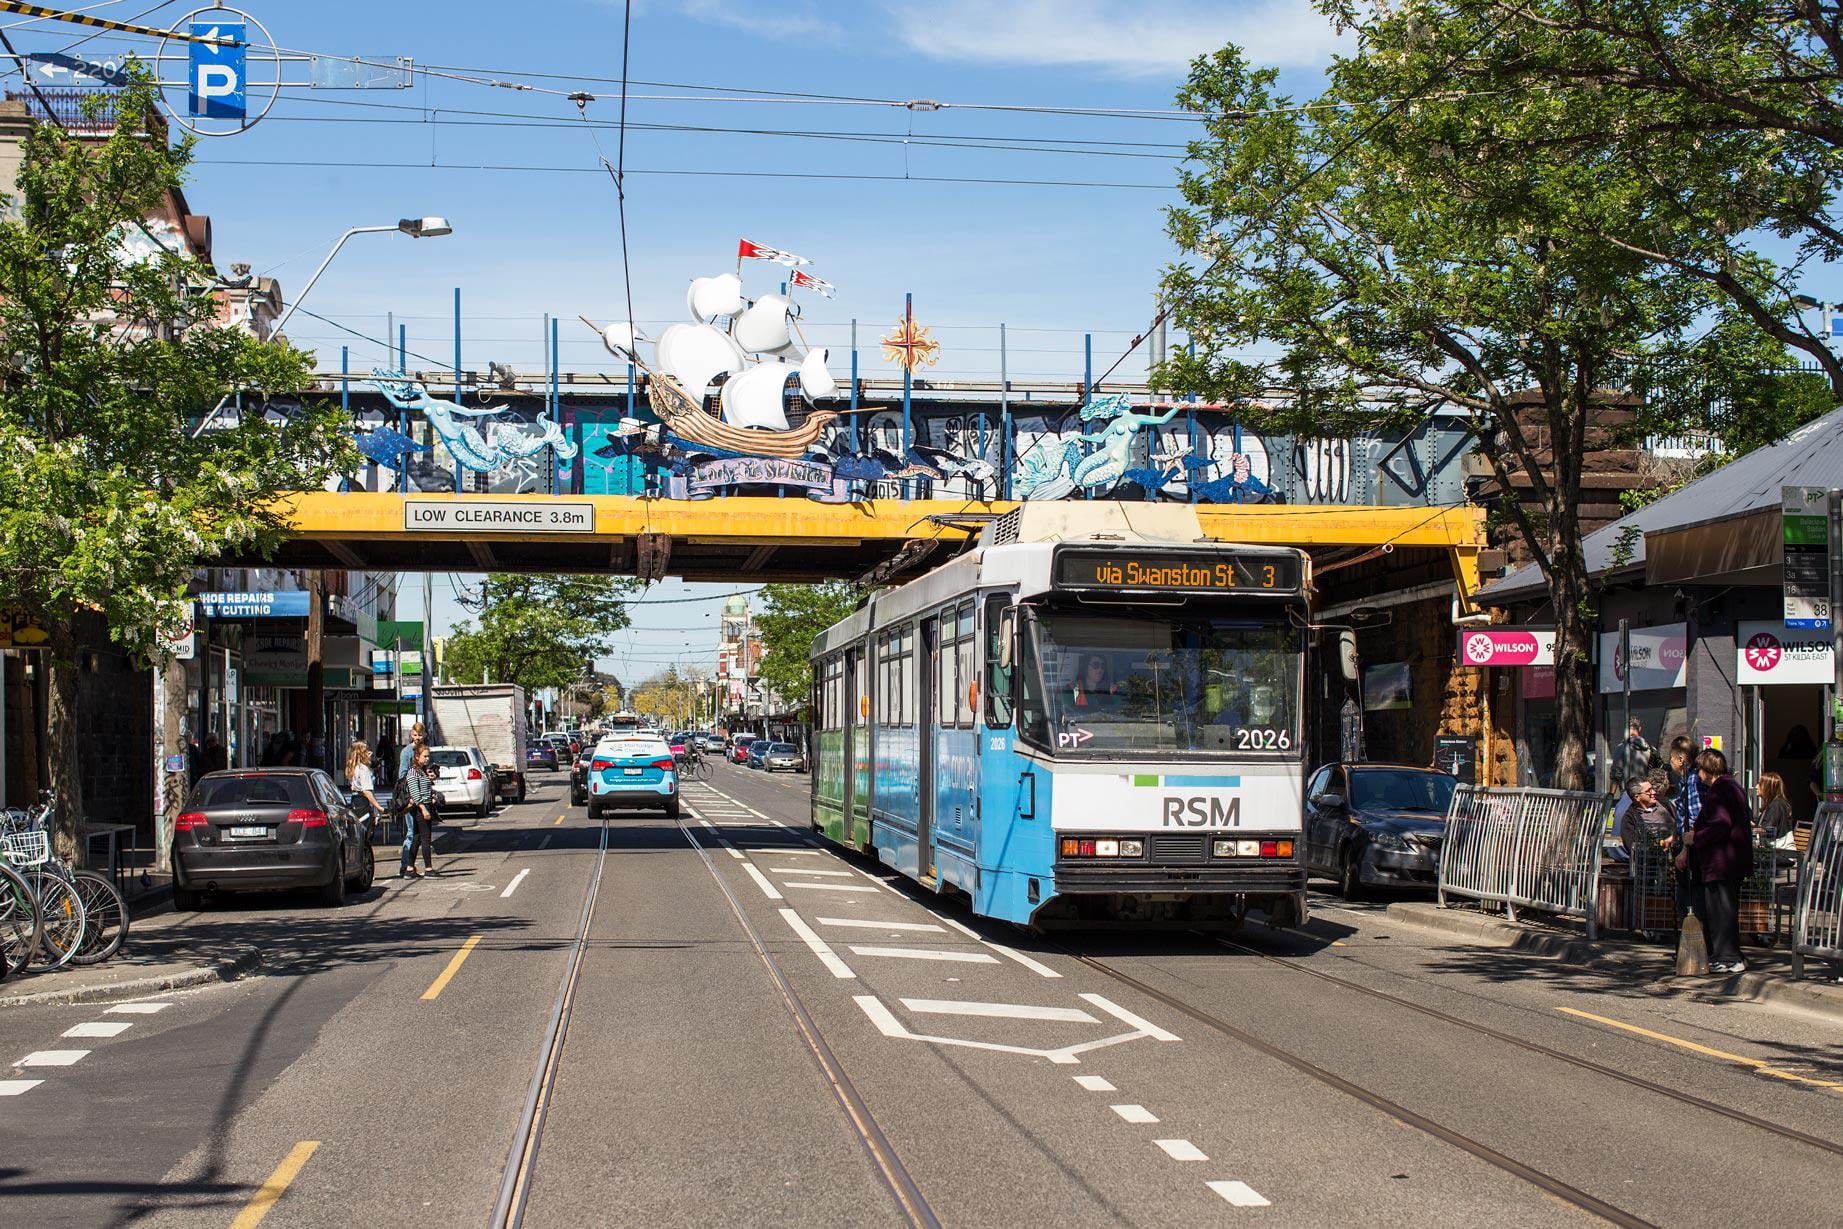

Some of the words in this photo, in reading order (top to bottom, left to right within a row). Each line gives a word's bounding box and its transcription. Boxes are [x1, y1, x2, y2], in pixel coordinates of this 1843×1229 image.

[73, 60, 117, 79] 220
[198, 64, 238, 115] P
[692, 463, 734, 485] Lady
[765, 459, 785, 481] St
[788, 463, 832, 484] Kilda
[414, 509, 447, 523] LOW
[455, 509, 543, 524] CLEARANCE
[549, 509, 585, 524] 3.8m
[1096, 561, 1122, 585] via
[1127, 562, 1211, 586] Swanston
[1215, 564, 1236, 588] St
[1262, 565, 1275, 588] 3
[227, 592, 275, 603] REPAIRS
[222, 605, 271, 616] CUTTING
[1813, 603, 1828, 617] 38
[1493, 643, 1534, 653] WILSON
[1783, 640, 1835, 653] WILSON
[1784, 653, 1793, 661] ST
[1792, 653, 1812, 661] KILDA
[1812, 653, 1828, 661] EAST
[990, 738, 1006, 751] 2026
[1237, 729, 1291, 750] 2026
[1163, 797, 1241, 827] RSM
